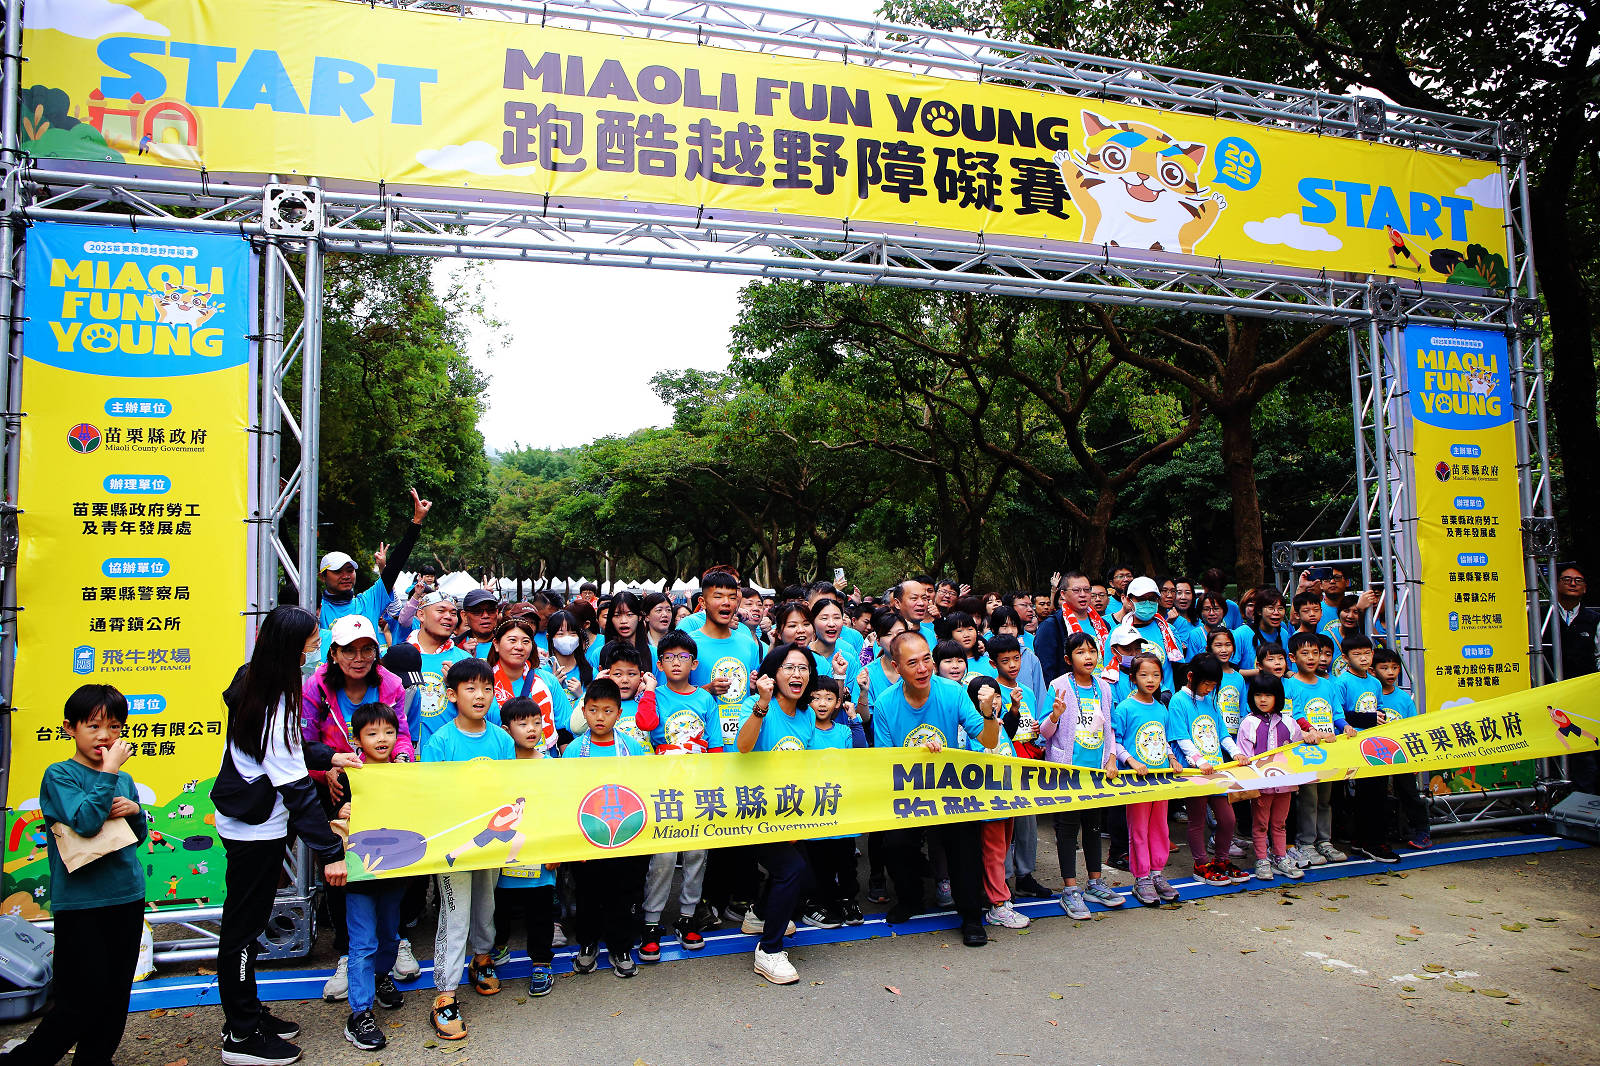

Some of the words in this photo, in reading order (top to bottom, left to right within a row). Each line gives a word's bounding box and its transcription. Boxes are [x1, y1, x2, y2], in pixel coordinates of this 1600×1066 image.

[97, 36, 438, 125] START
[503, 48, 739, 112] MIAOLI
[755, 77, 873, 128] FUN
[886, 93, 1069, 151] YOUNG
[500, 101, 1071, 220] 跑酷越野障礙賽
[1224, 142, 1255, 168] 20
[1221, 163, 1252, 185] 25
[1298, 177, 1473, 242] START
[50, 258, 225, 295] MIAOLI
[61, 291, 156, 321] FUN
[48, 321, 225, 357] YOUNG
[1417, 349, 1498, 373] MIAOLI
[1424, 371, 1469, 392] FUN
[111, 401, 166, 414] 主辦單位
[1419, 392, 1502, 416] YOUNG
[104, 427, 207, 444] 苗栗縣政府
[132, 445, 158, 453] County
[1452, 464, 1499, 476] 苗栗縣政府
[110, 478, 165, 490] 辦理單位
[73, 502, 200, 517] 苗栗縣政府勞工
[82, 520, 192, 536] 及青年發展處
[1441, 515, 1499, 525] 苗栗縣政府勞工
[1446, 528, 1496, 538] 及青年發展處
[109, 562, 164, 574] 協辦單位
[1449, 572, 1498, 582] 苗栗縣警察局
[82, 586, 190, 601] 苗栗縣警察局
[1454, 592, 1496, 602] 通霄鎮公所
[90, 616, 181, 632] 通霄鎮公所
[1461, 613, 1502, 624] 飛牛牧場
[102, 648, 191, 665] 飛牛牧場
[1436, 663, 1520, 676] 台灣電力股份有限公司
[1457, 676, 1500, 688] 通霄發電廠
[1400, 712, 1522, 757] 苗栗縣政府
[1477, 739, 1530, 757] Government
[893, 762, 1012, 791] MIAOLI
[1020, 768, 1082, 790] FUN
[650, 782, 842, 822] 苗栗縣政府
[652, 824, 700, 840] Miaoli
[703, 822, 753, 837] County
